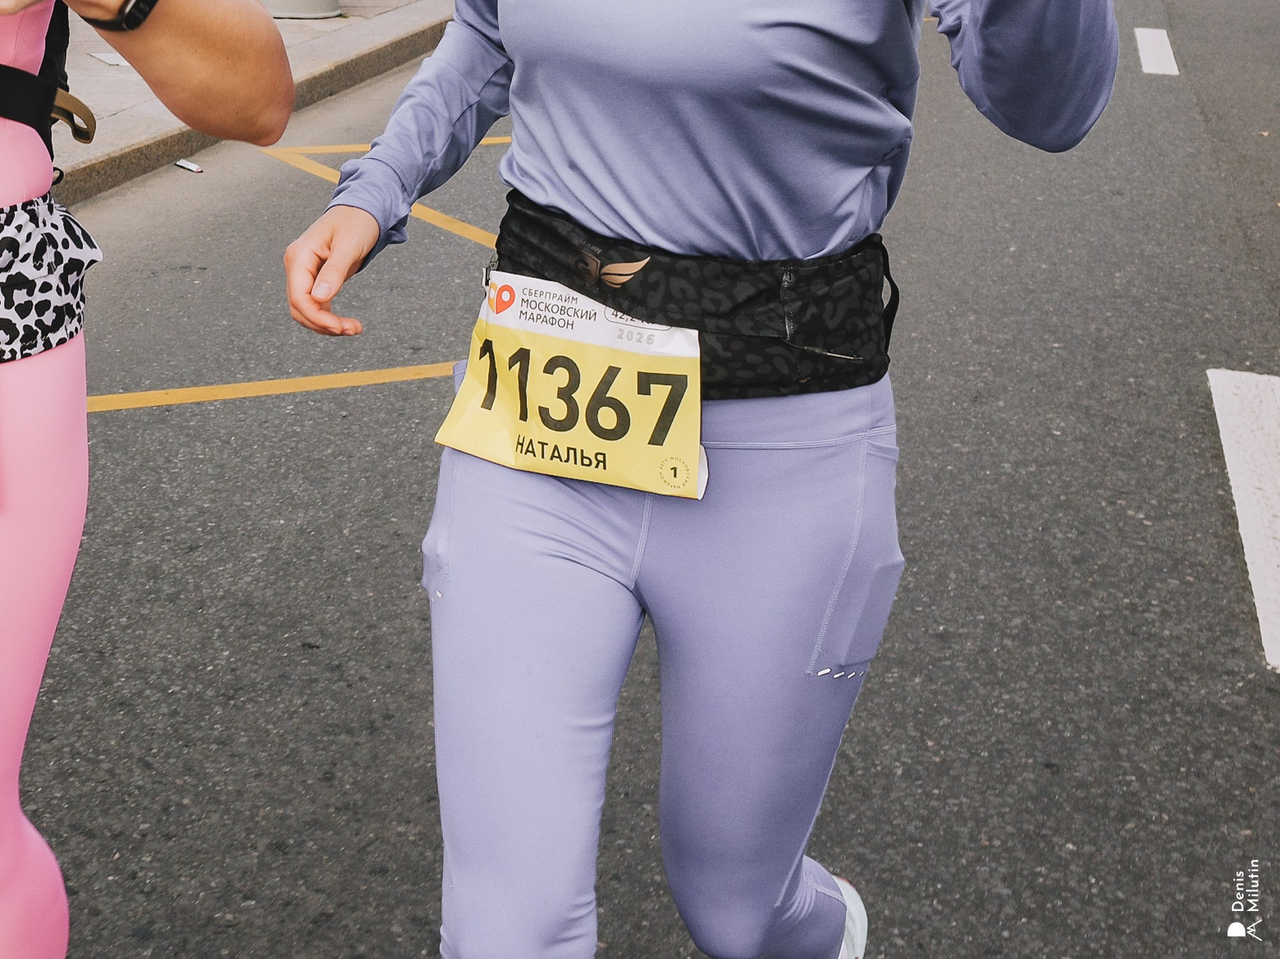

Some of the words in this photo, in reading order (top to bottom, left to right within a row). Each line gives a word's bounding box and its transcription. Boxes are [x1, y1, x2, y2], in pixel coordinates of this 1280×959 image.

[522, 287, 578, 305] СБЕРПРАЙМ
[519, 310, 575, 330] МАРАФОН
[520, 298, 597, 322] МОСКОВСКИЙ
[617, 328, 656, 345] 2026
[478, 338, 688, 447] 11367
[515, 434, 607, 471] НАТАЛЬЯ
[670, 467, 677, 478] 1
